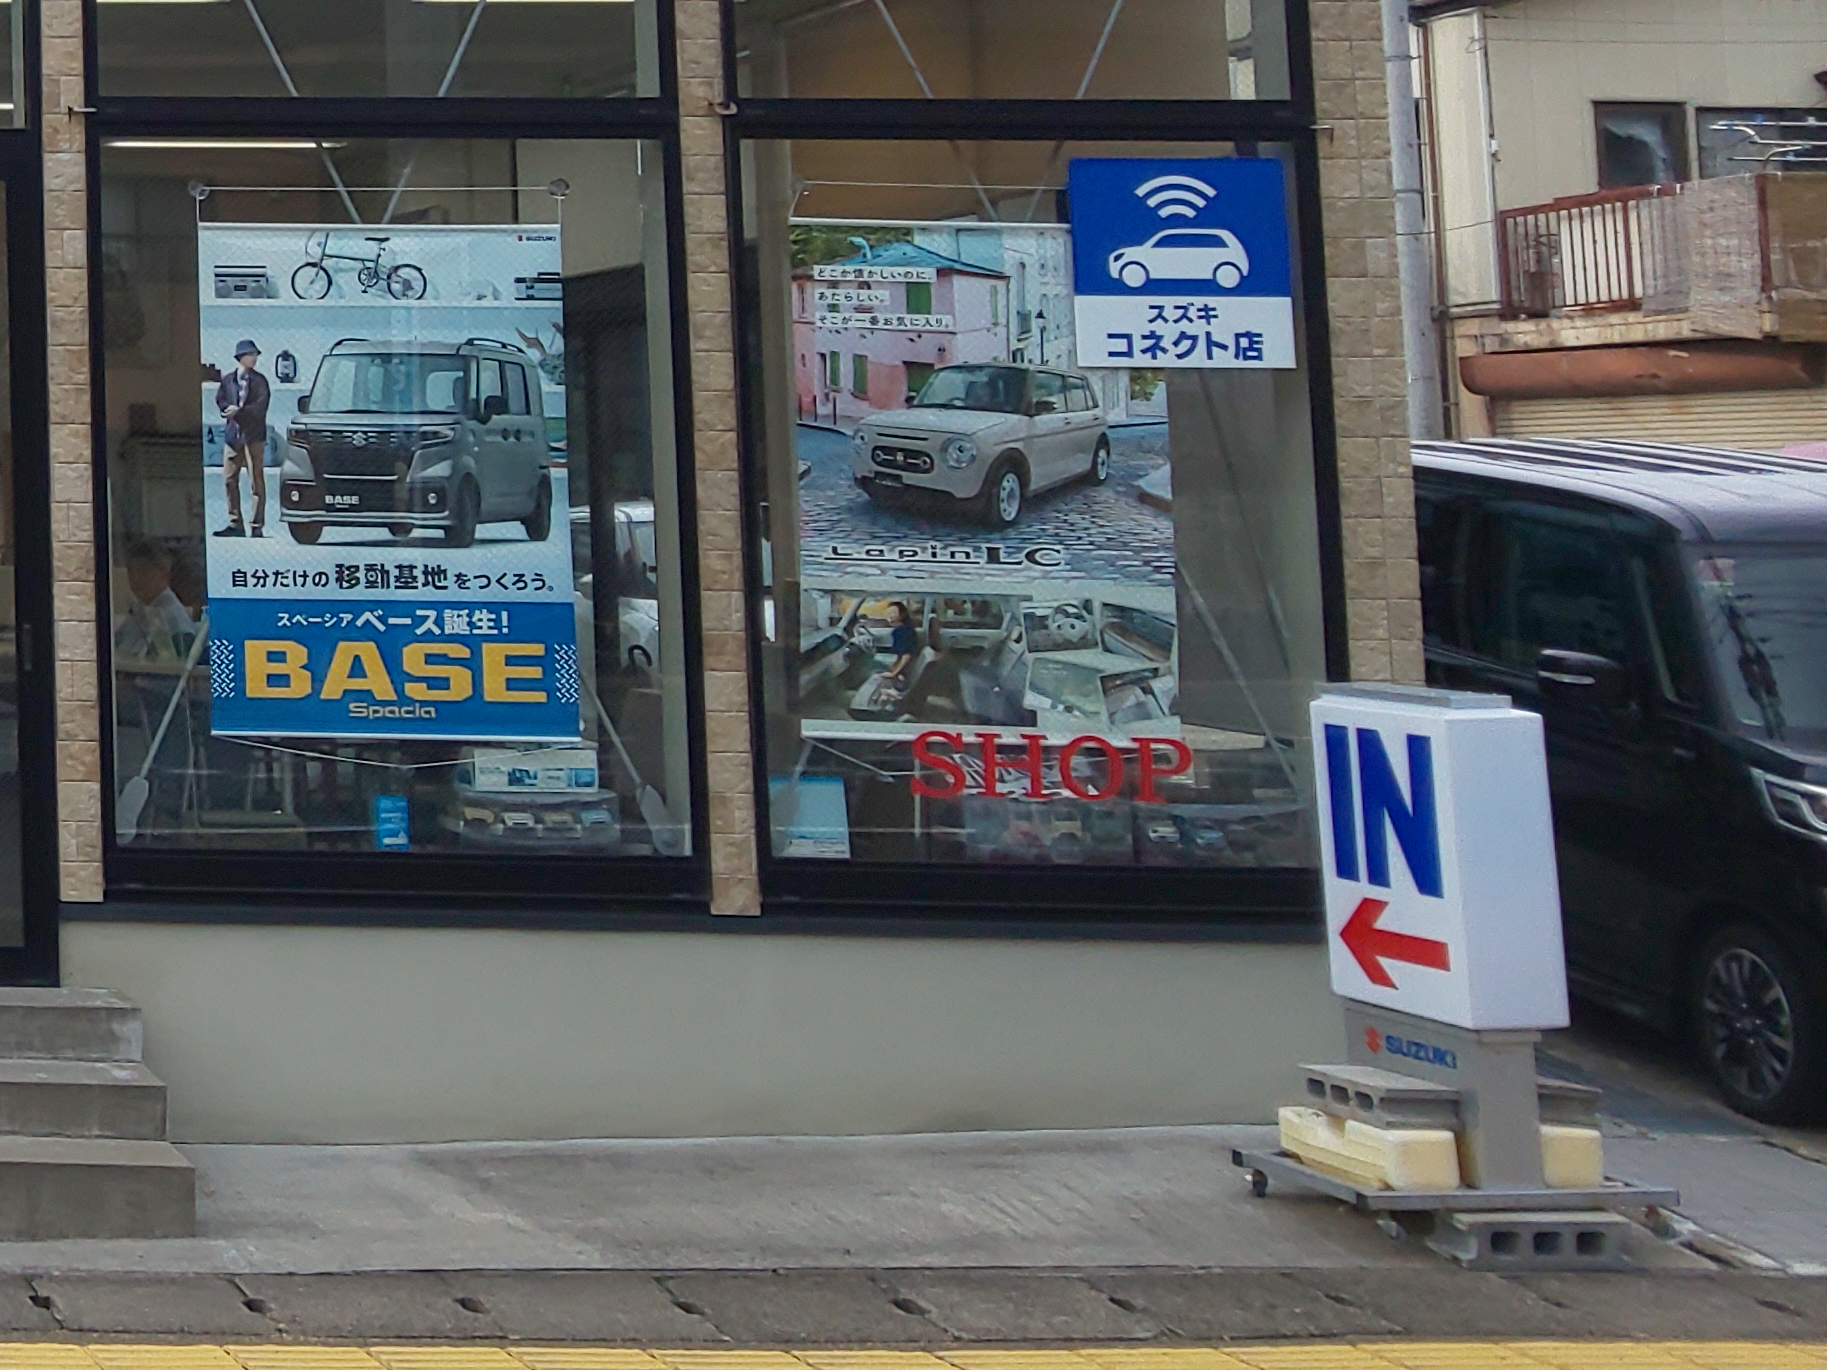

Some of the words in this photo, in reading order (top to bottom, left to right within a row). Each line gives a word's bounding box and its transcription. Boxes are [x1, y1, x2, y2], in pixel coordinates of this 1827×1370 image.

[1148, 302, 1219, 325] スズキ
[1107, 331, 1264, 362] コネクト店
[325, 495, 360, 505] BASE
[831, 543, 972, 562] Lapin
[984, 546, 1063, 568] LC
[244, 640, 548, 703] BASE
[348, 702, 437, 720] Spacia
[911, 730, 1194, 804] SHOP
[1324, 724, 1444, 898] IN
[1385, 1035, 1458, 1069] SUZUKI
